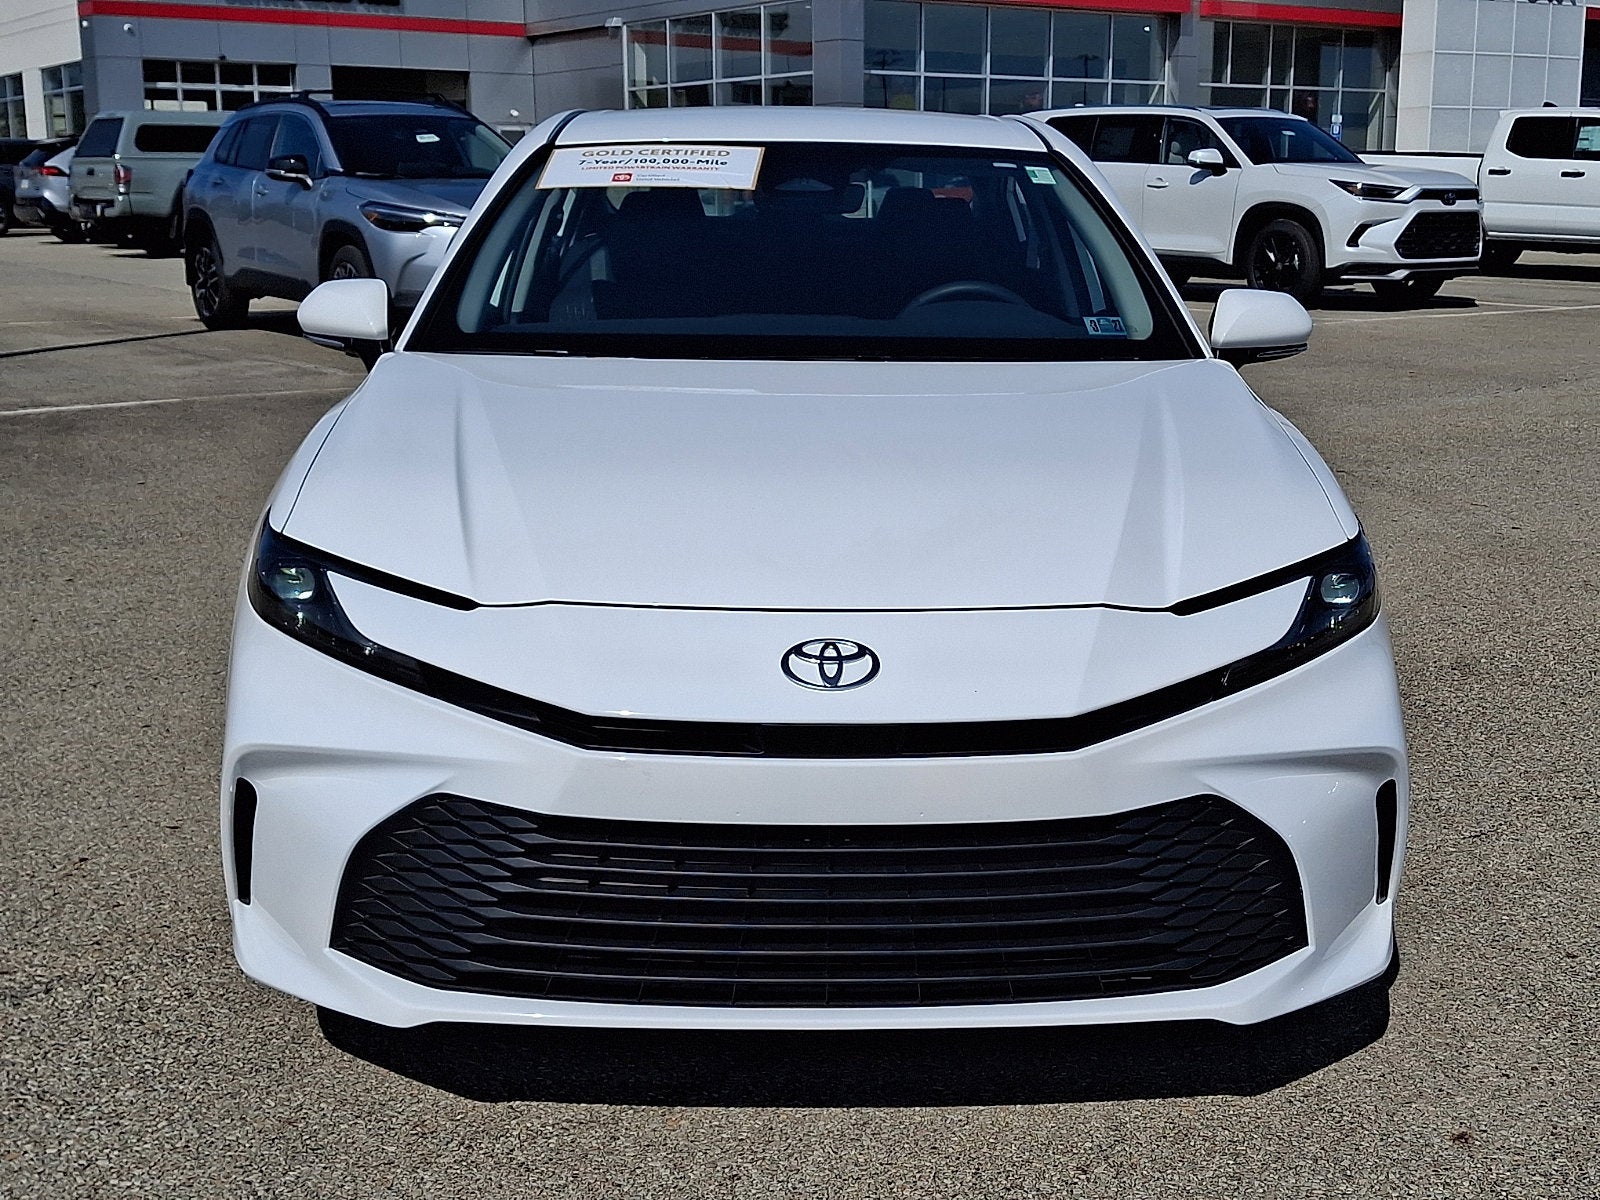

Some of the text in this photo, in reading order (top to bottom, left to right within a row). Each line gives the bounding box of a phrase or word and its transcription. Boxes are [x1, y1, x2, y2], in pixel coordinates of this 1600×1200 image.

[582, 149, 730, 157] GOLD CERTIFIED
[579, 158, 728, 166] 7-Year/100,000-Mile
